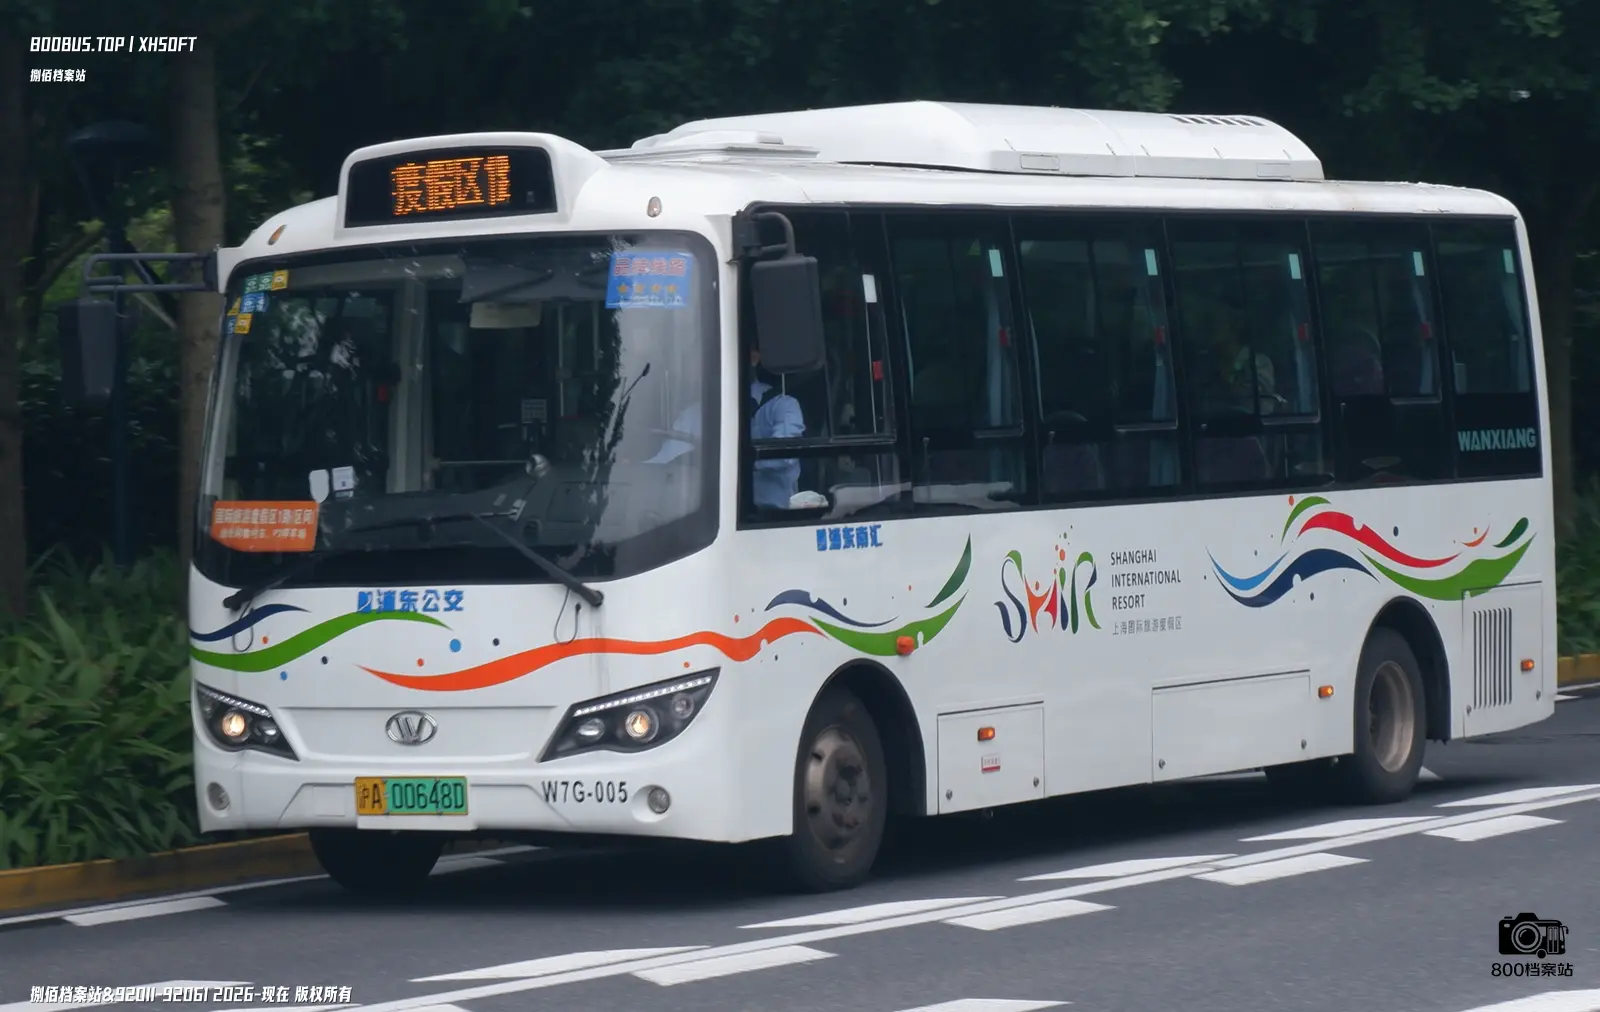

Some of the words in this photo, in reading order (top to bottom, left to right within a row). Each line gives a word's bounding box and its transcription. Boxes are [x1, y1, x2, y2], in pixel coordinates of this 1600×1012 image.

[1457, 427, 1537, 452] WANXIANG
[1110, 549, 1157, 566] SHANGHAI
[1111, 569, 1182, 588] INTERNATIONAL
[376, 588, 464, 613] 浦东公交
[1112, 594, 1146, 611] RESORT
[1112, 615, 1182, 636] 上海国际旅游度假区
[541, 780, 628, 804] W7G-005
